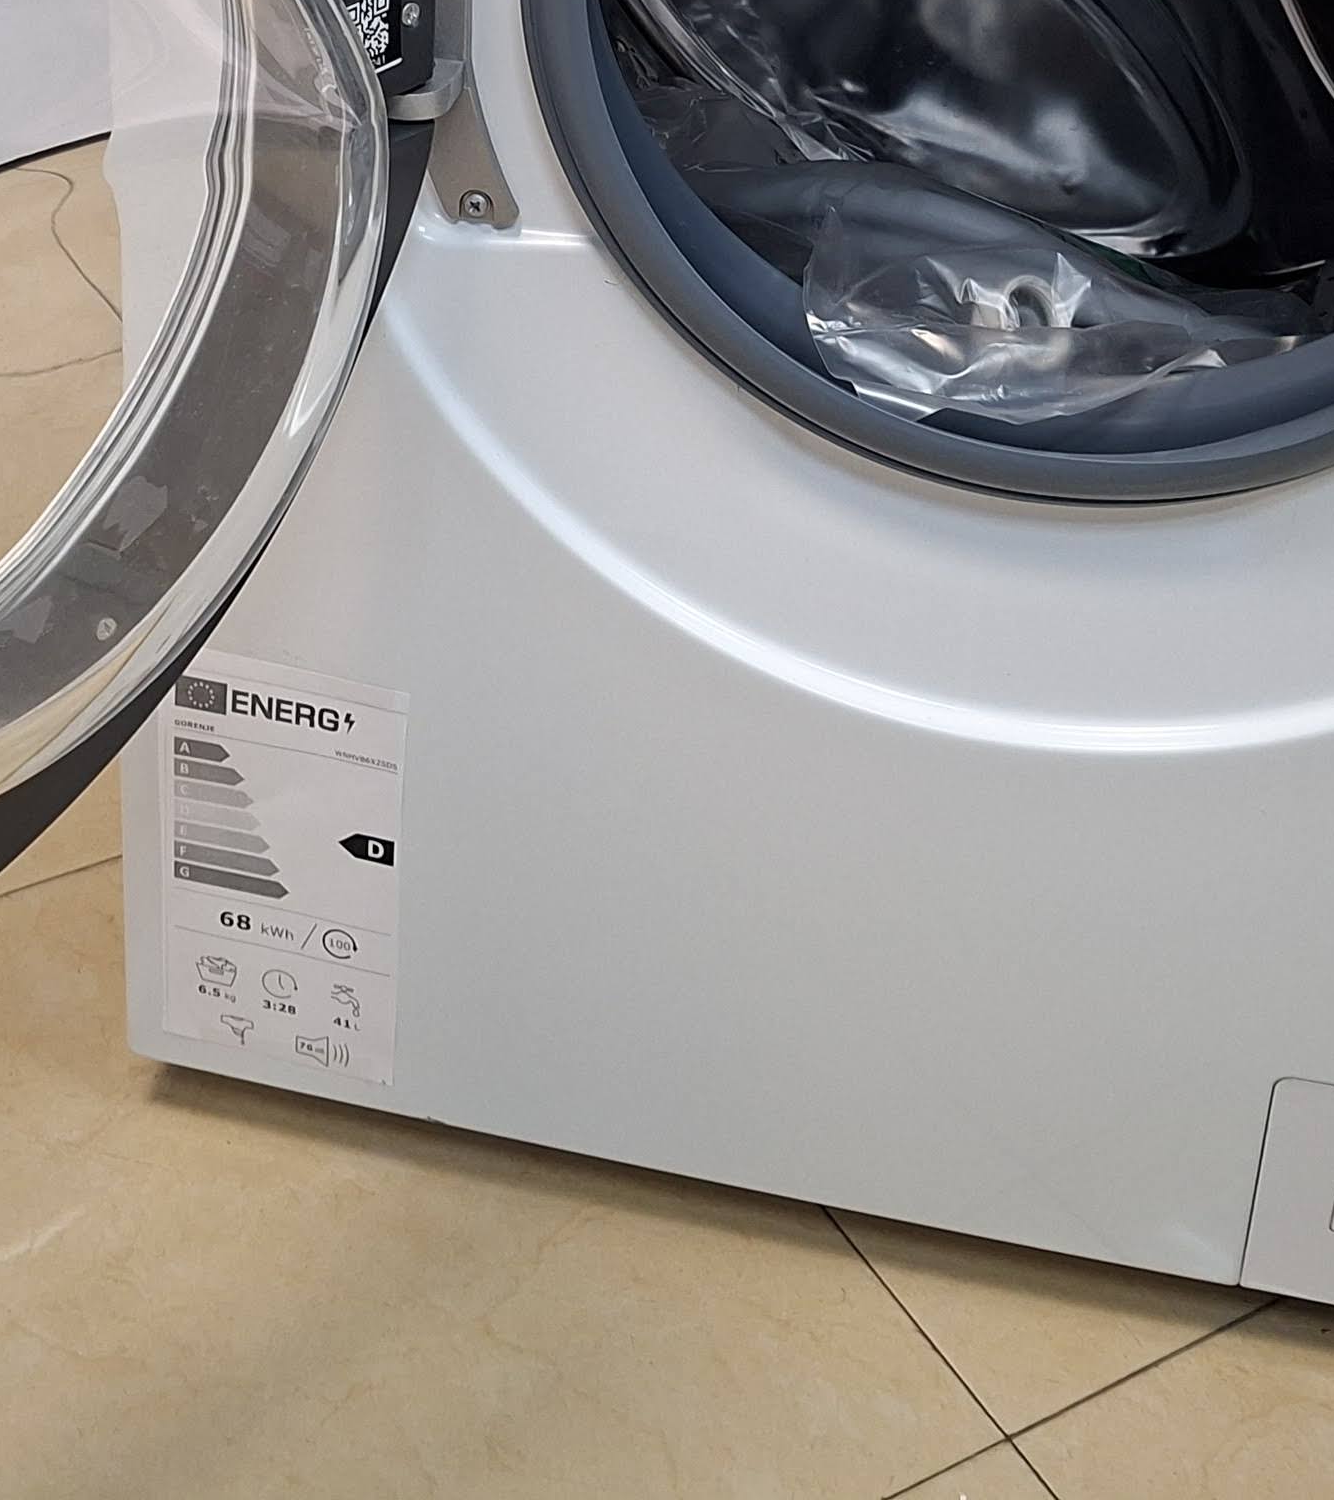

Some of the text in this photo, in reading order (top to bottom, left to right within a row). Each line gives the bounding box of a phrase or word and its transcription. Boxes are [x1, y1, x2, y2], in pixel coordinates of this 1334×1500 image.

[231, 688, 340, 733] ENERG
[174, 718, 216, 733] GORENJE
[179, 741, 190, 754] A
[179, 763, 189, 775] B
[179, 846, 187, 857] F
[367, 839, 385, 860] D
[179, 866, 190, 878] G
[220, 911, 294, 941] 68 kWh
[328, 937, 351, 952] 100
[198, 984, 221, 998] 6.5
[262, 999, 297, 1015] 3:28
[333, 1016, 350, 1029] 41
